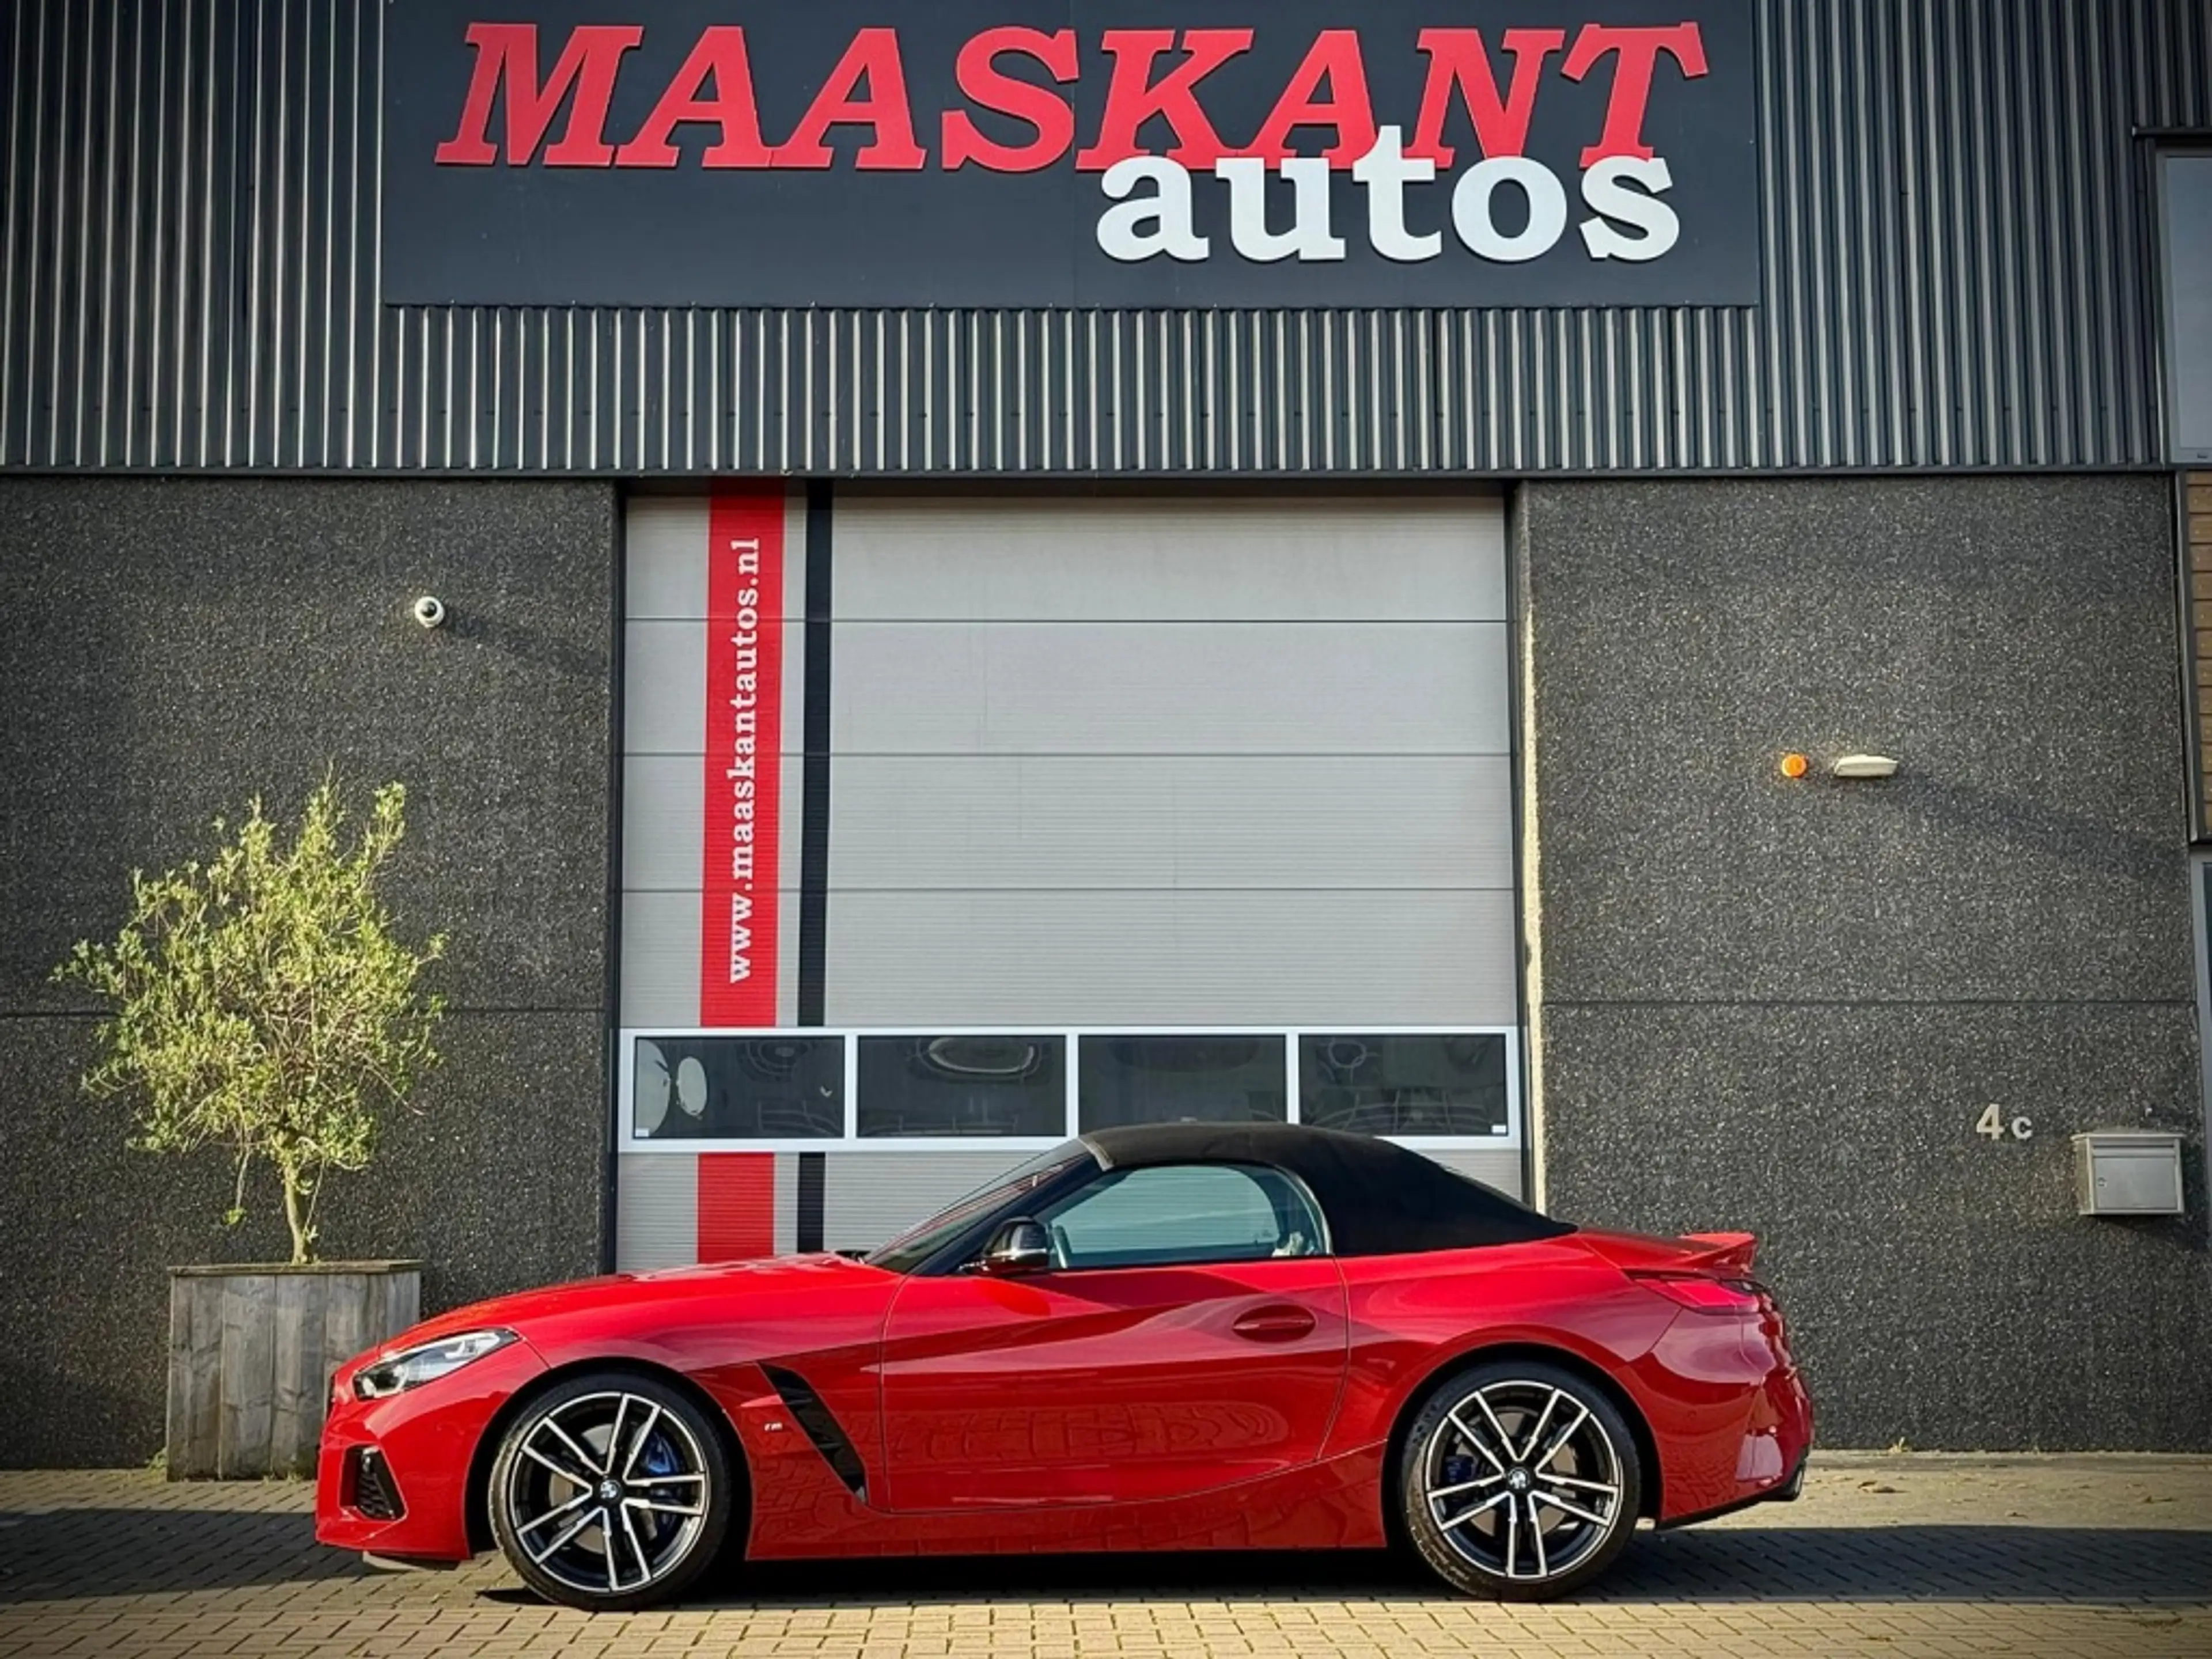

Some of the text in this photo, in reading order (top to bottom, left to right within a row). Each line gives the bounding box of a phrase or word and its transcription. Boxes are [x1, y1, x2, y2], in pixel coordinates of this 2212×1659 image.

[435, 22, 1709, 172] MAASKANT
[1096, 124, 1680, 262] autos
[728, 539, 759, 983] www.maaskantautos.nl
